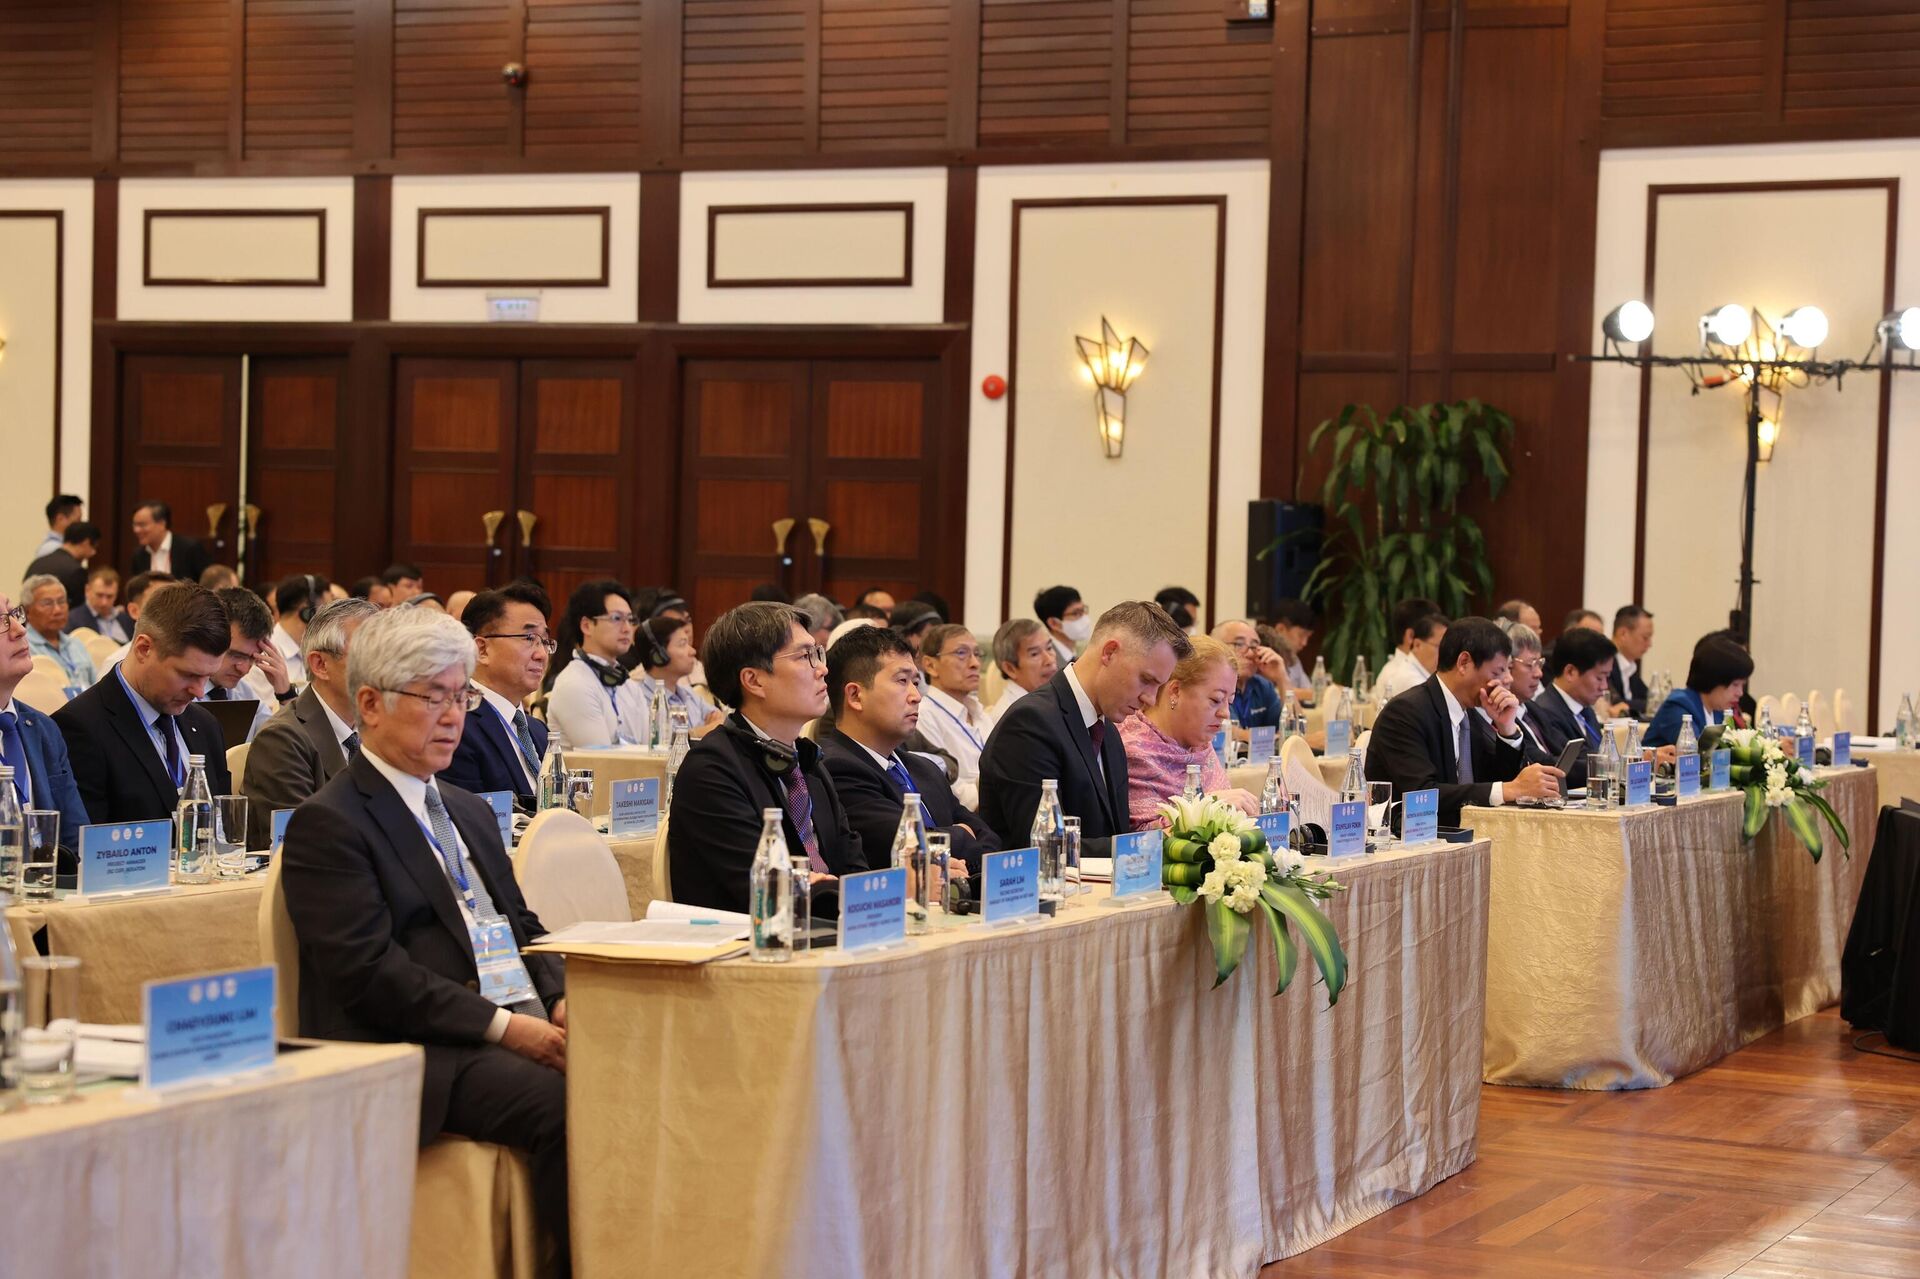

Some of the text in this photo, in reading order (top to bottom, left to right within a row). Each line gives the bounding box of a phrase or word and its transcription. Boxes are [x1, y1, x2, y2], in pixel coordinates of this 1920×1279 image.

[96, 846, 157, 860] ZYBAILO ANTON
[999, 877, 1016, 888] SARAH
